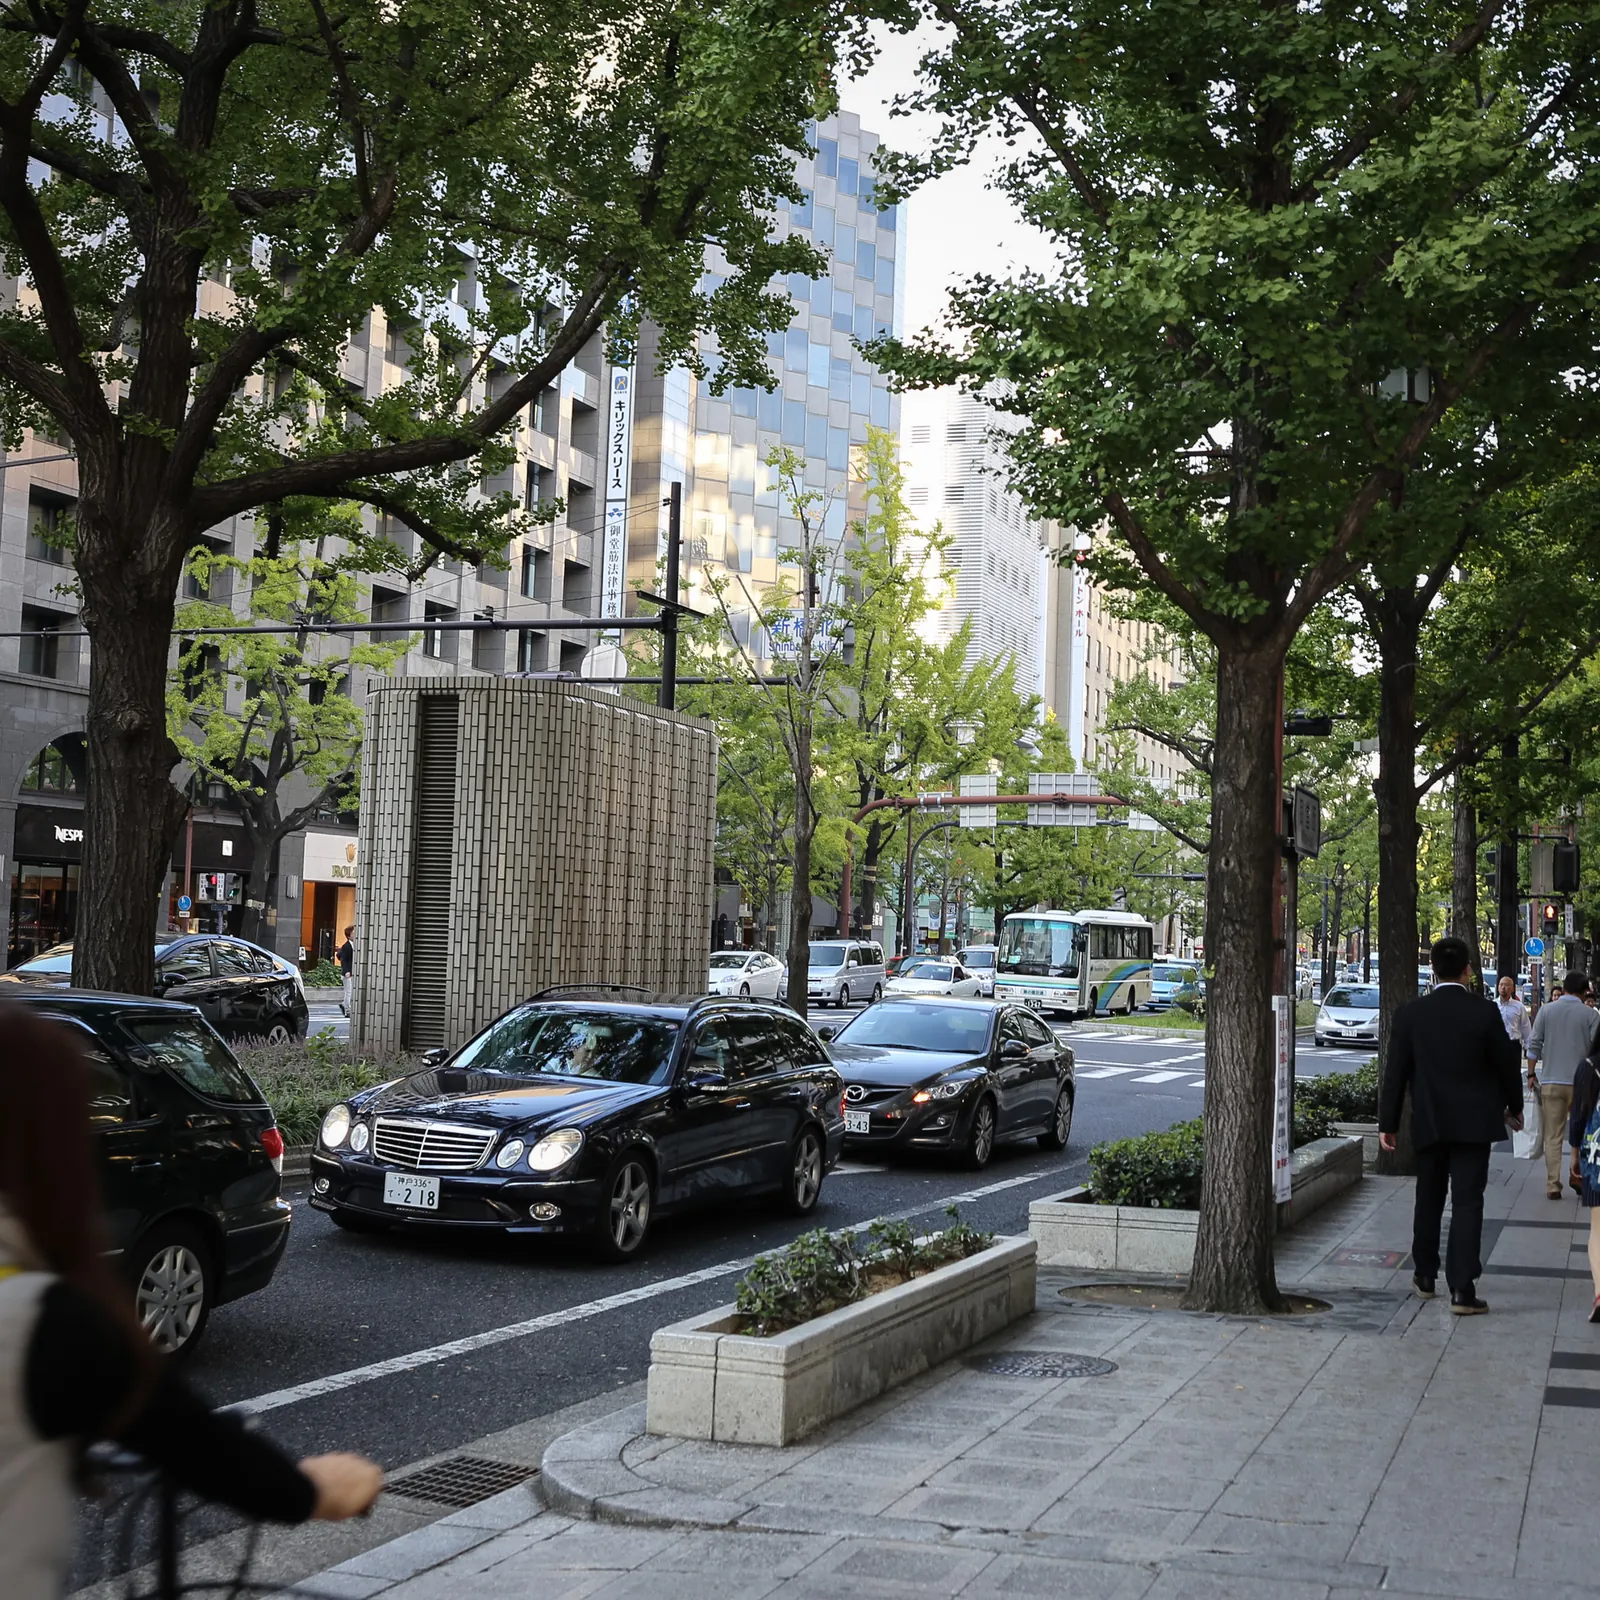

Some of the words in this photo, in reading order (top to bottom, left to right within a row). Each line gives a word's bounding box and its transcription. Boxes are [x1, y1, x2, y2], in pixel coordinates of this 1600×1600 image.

[612, 400, 626, 489] キリックスリース
[607, 525, 621, 618] 御堂筋法律事務
